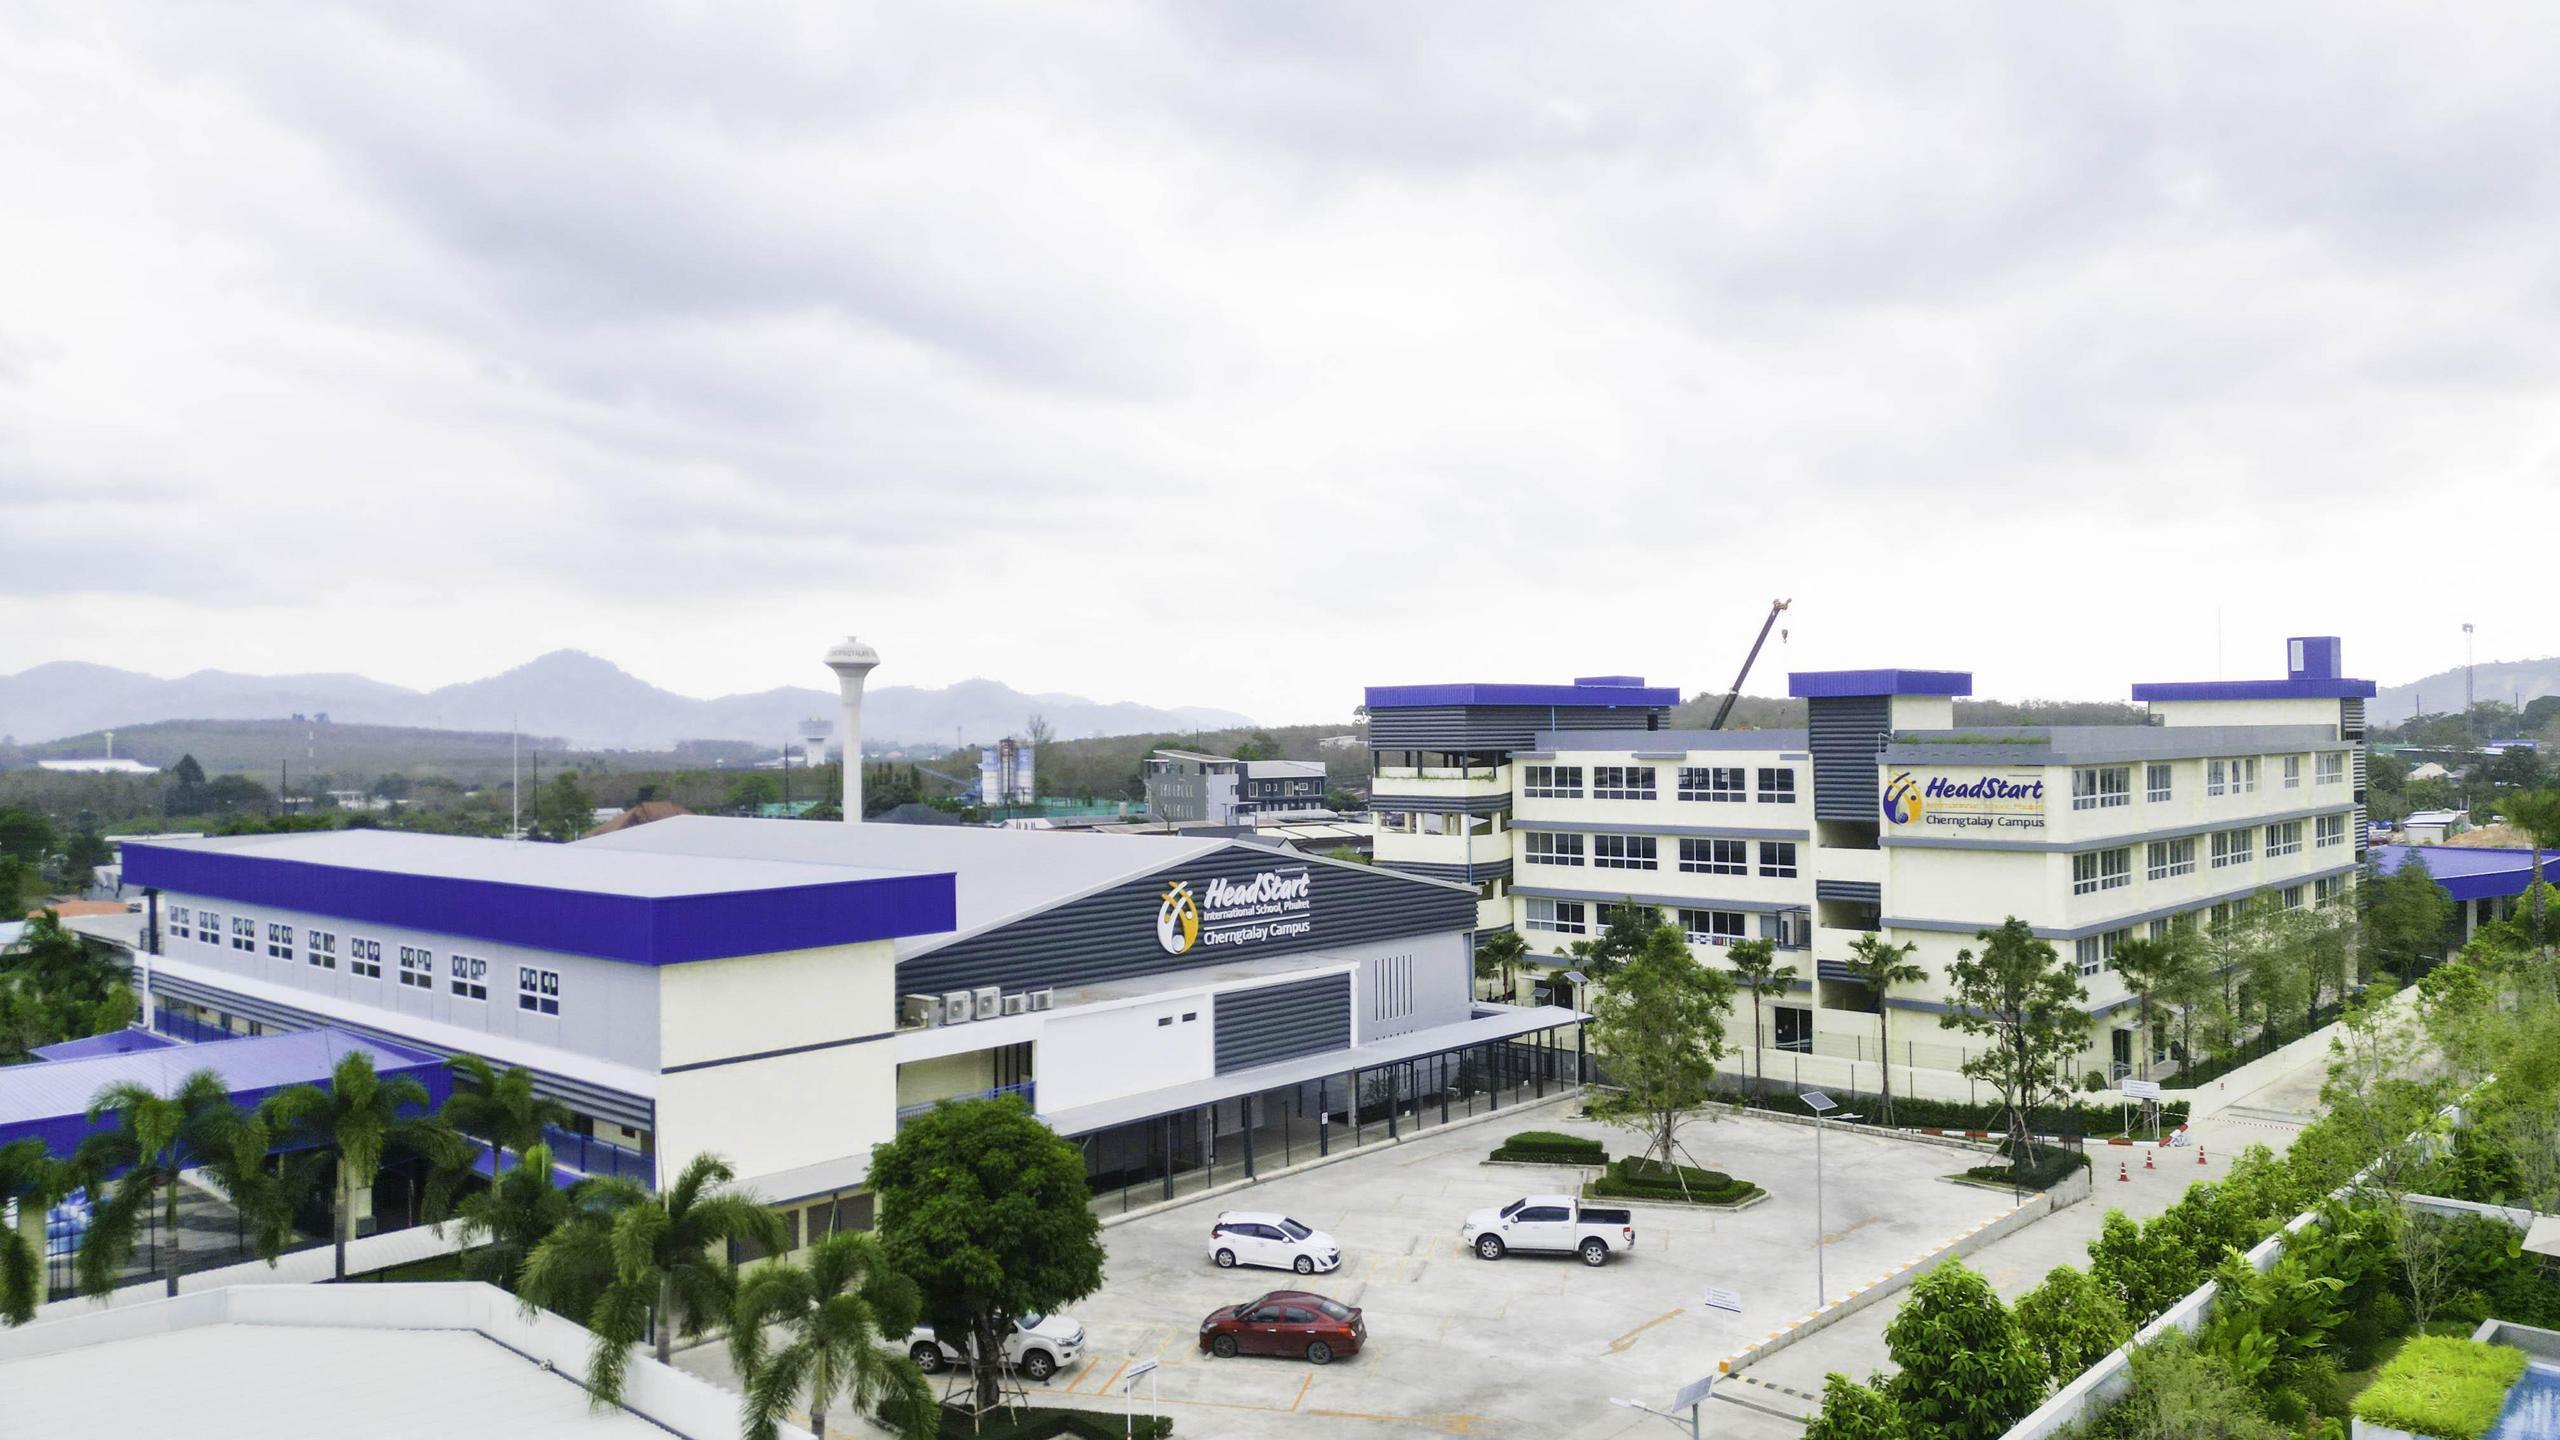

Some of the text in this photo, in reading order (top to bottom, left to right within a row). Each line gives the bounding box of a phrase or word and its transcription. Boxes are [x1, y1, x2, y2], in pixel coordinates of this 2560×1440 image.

[1926, 776, 2044, 799] HeadStart
[1926, 815, 2045, 829] Cherngtalay Campus
[1204, 873, 1310, 908] HeadStart
[1203, 900, 1310, 921] International School, Phuket
[1203, 922, 1310, 945] Cherngtalay Campus
